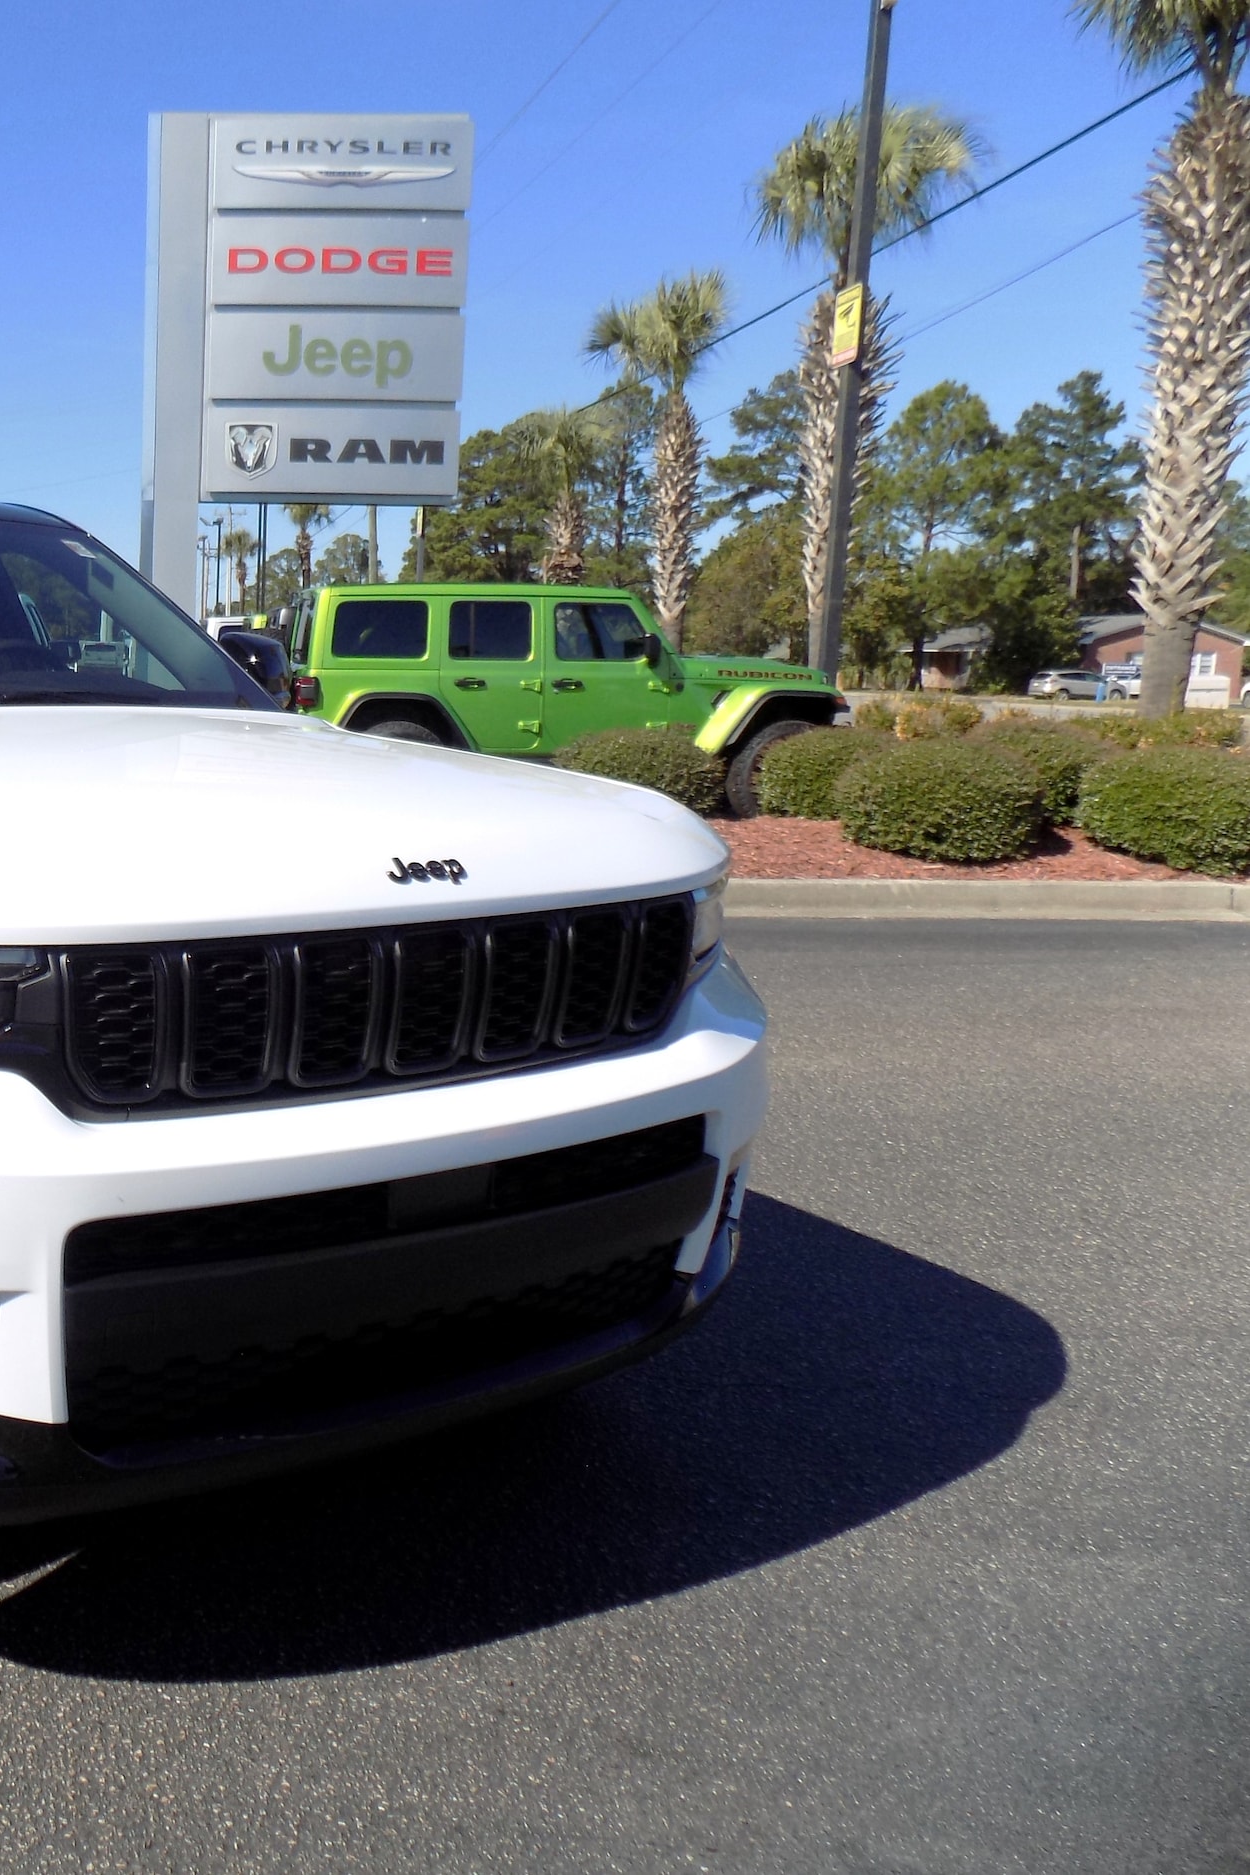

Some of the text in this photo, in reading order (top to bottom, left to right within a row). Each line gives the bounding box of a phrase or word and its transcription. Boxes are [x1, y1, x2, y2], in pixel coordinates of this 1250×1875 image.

[235, 140, 451, 155] CHRYSLER
[228, 247, 453, 275] DODGE
[263, 324, 412, 387] Jeep
[289, 438, 444, 464] RAM
[718, 669, 812, 680] RUBICON
[386, 857, 468, 885] Jeep
